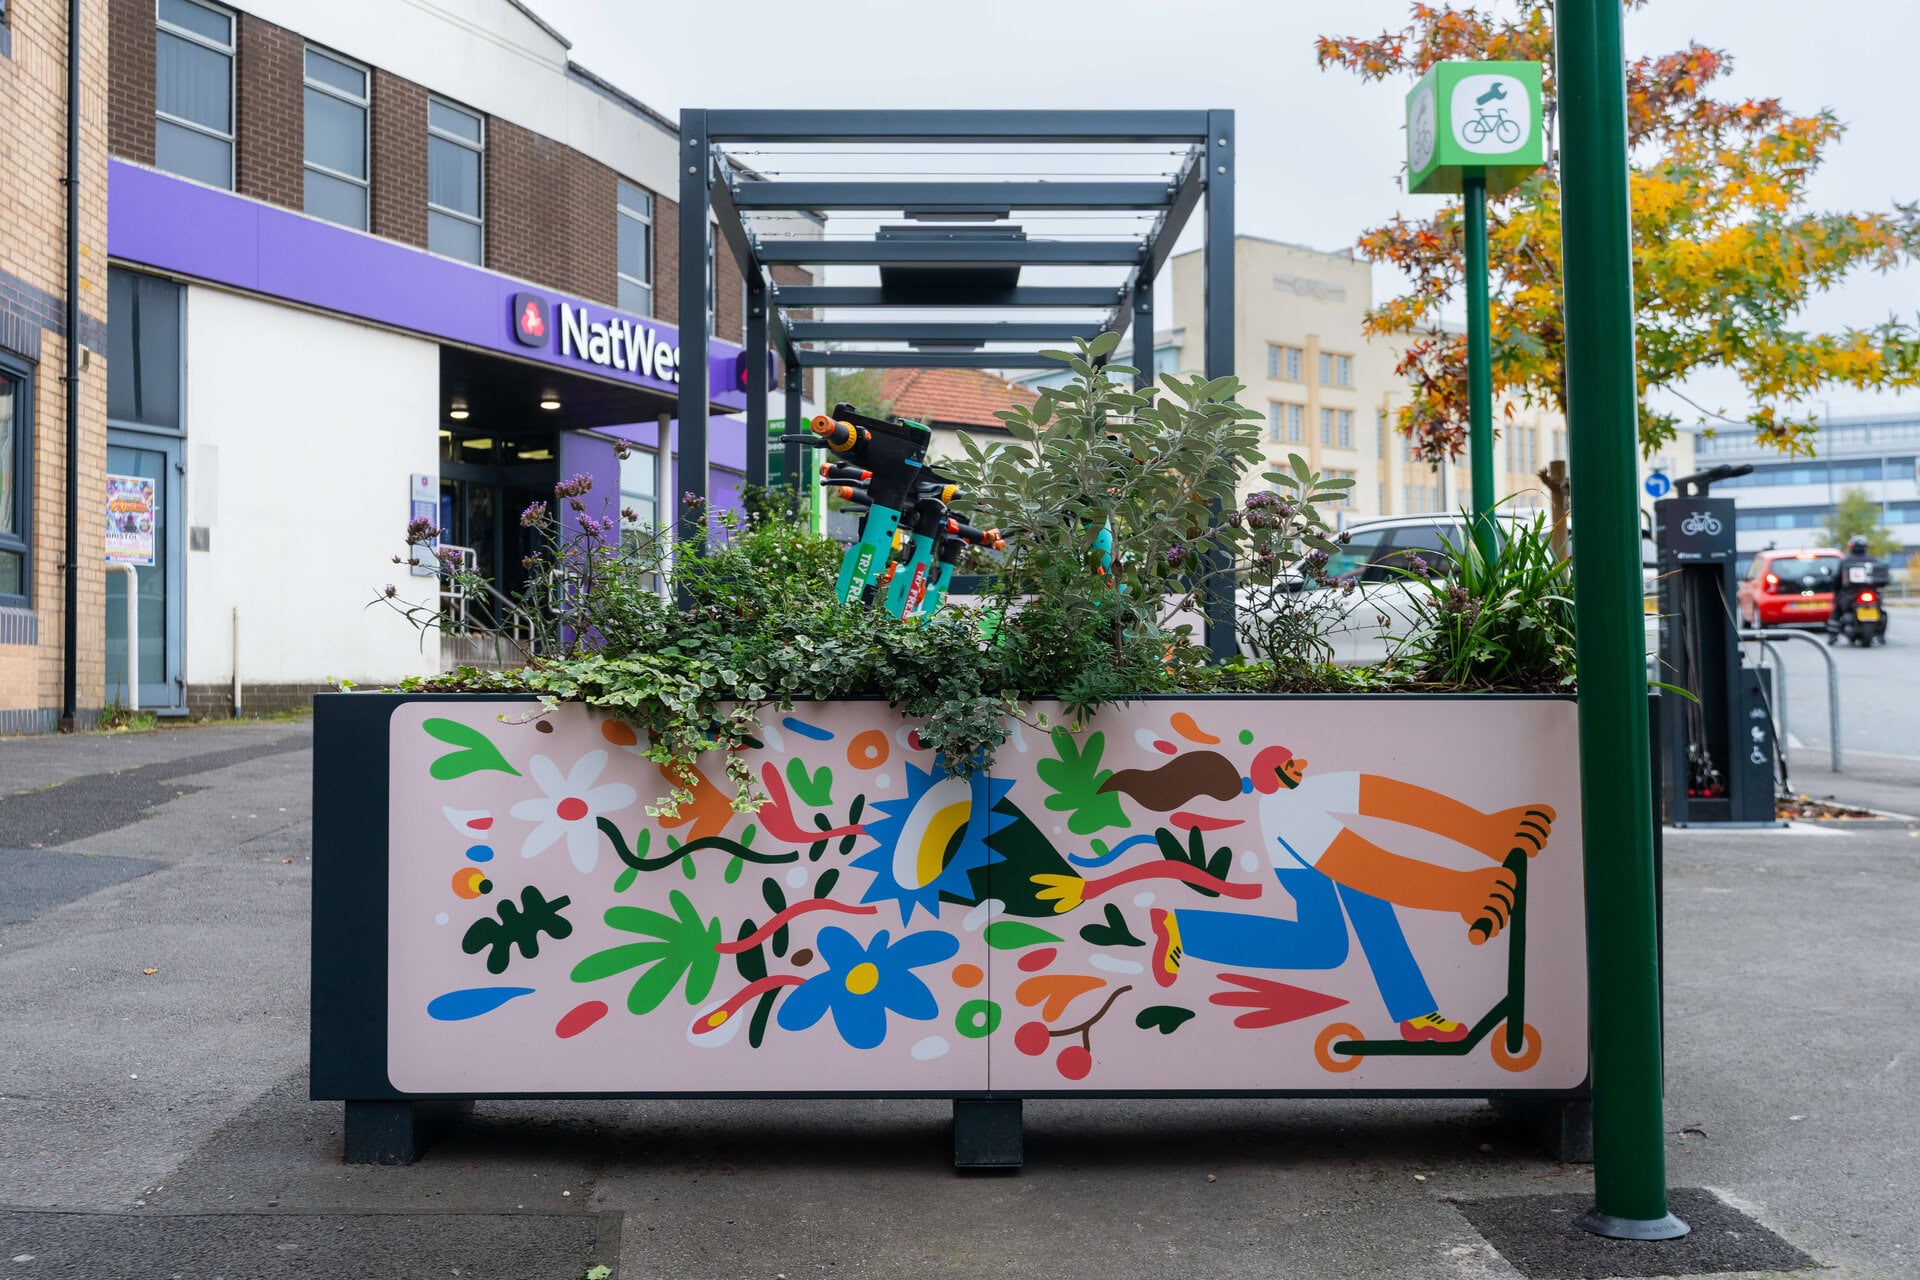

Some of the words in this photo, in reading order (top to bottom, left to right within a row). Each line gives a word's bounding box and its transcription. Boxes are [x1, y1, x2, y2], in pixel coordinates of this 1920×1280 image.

[560, 302, 680, 383] NatWe
[858, 553, 873, 575] TRY
[846, 576, 865, 603] FRE
[914, 570, 924, 588] TRY
